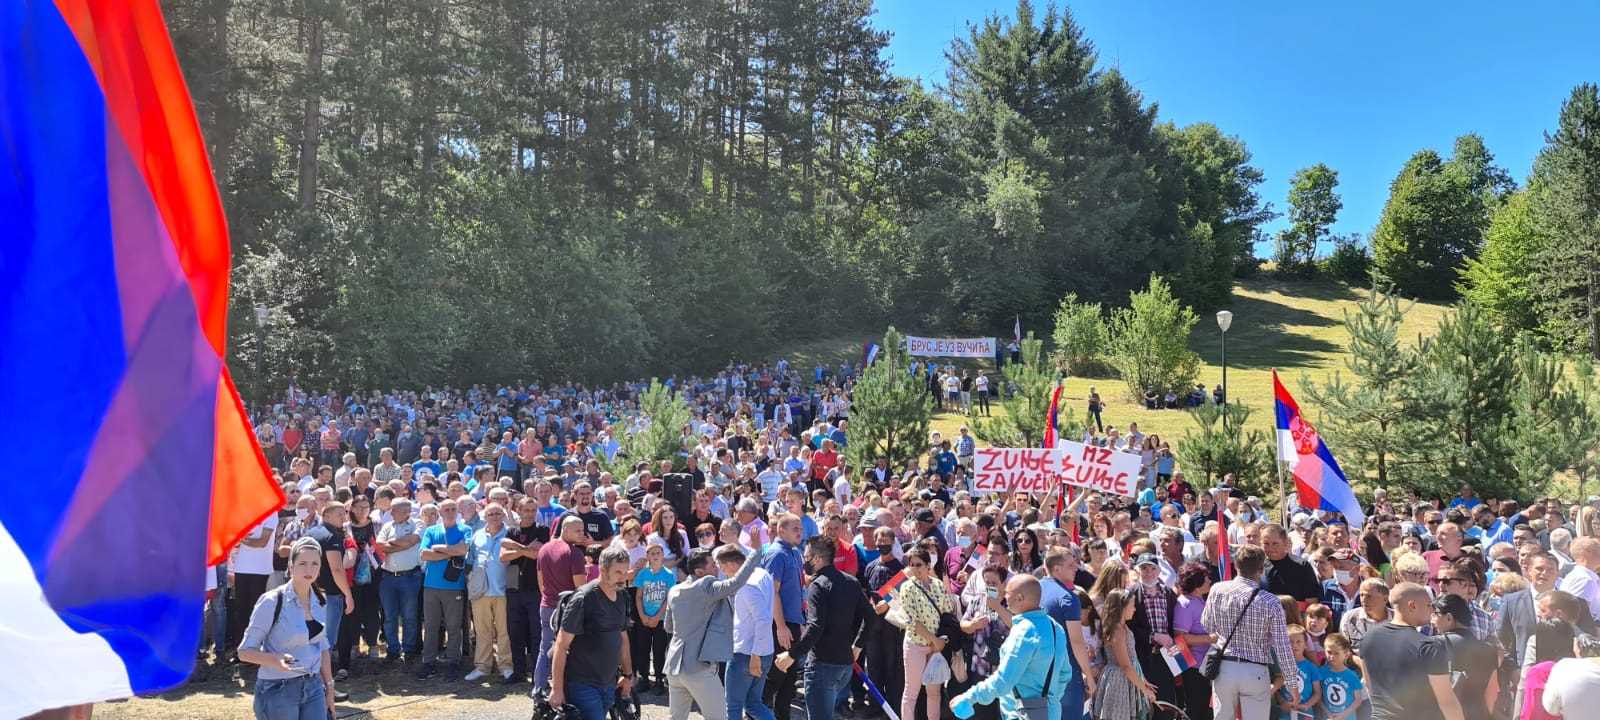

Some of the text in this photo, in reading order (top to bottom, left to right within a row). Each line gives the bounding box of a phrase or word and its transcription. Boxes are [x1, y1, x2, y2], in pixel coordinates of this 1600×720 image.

[911, 340, 990, 353] БРУС ЈЕ УЗ ВУЧИЋА
